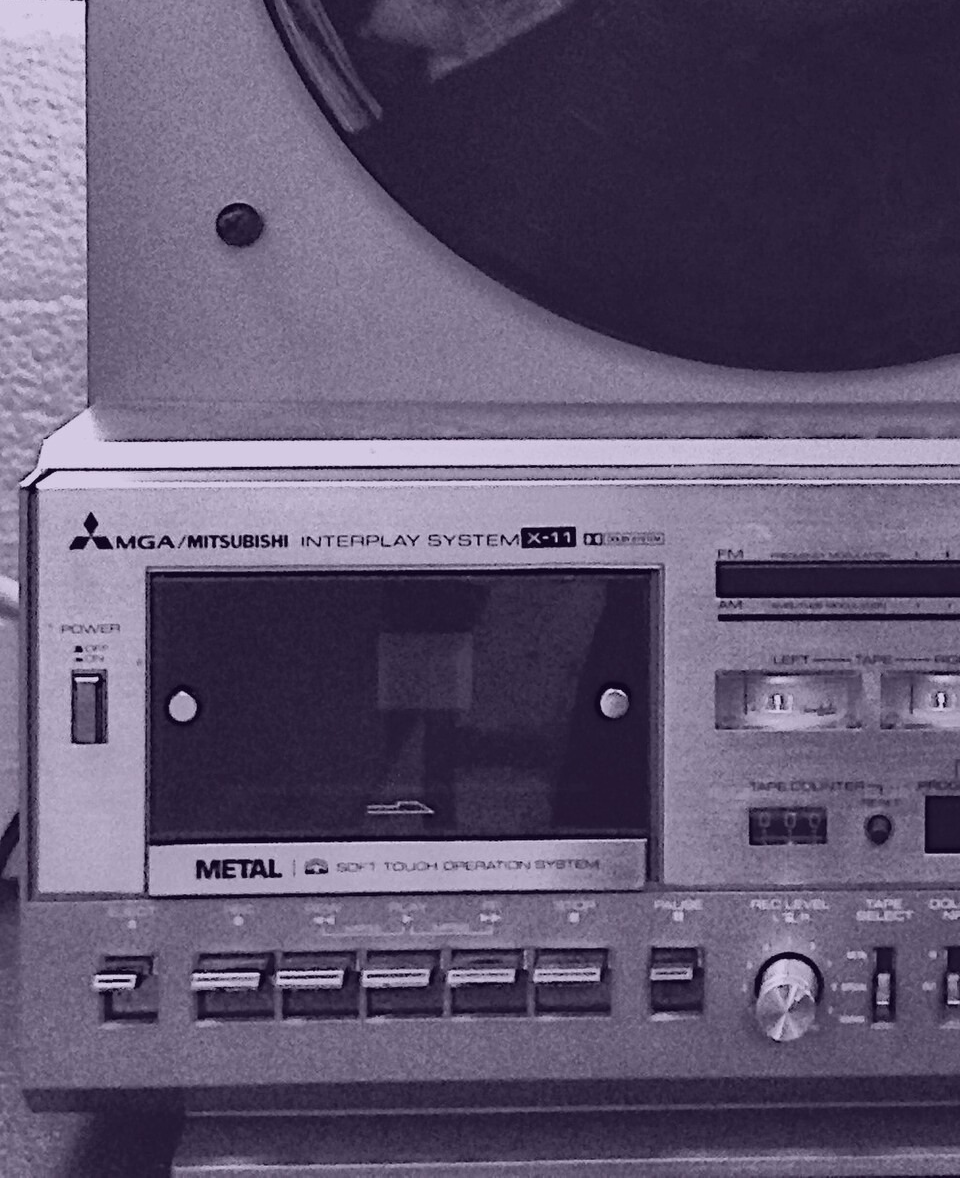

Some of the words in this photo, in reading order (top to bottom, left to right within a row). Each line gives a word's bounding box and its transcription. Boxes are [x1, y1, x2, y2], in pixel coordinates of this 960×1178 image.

[300, 534, 421, 548] INTERPLAY
[427, 532, 520, 548] SYSTEM
[526, 530, 574, 546] X-11
[717, 549, 744, 560] FM
[718, 600, 743, 609] AM
[61, 624, 120, 634] POWER
[195, 859, 282, 880] METAL
[336, 860, 376, 873] SOFT
[385, 860, 439, 872] TOUCH
[444, 860, 532, 872] OPERATION
[535, 859, 600, 871] SYSTEM
[785, 899, 829, 910] LEVEL
[866, 898, 903, 908] TAPE
[856, 911, 914, 921] SELECT
